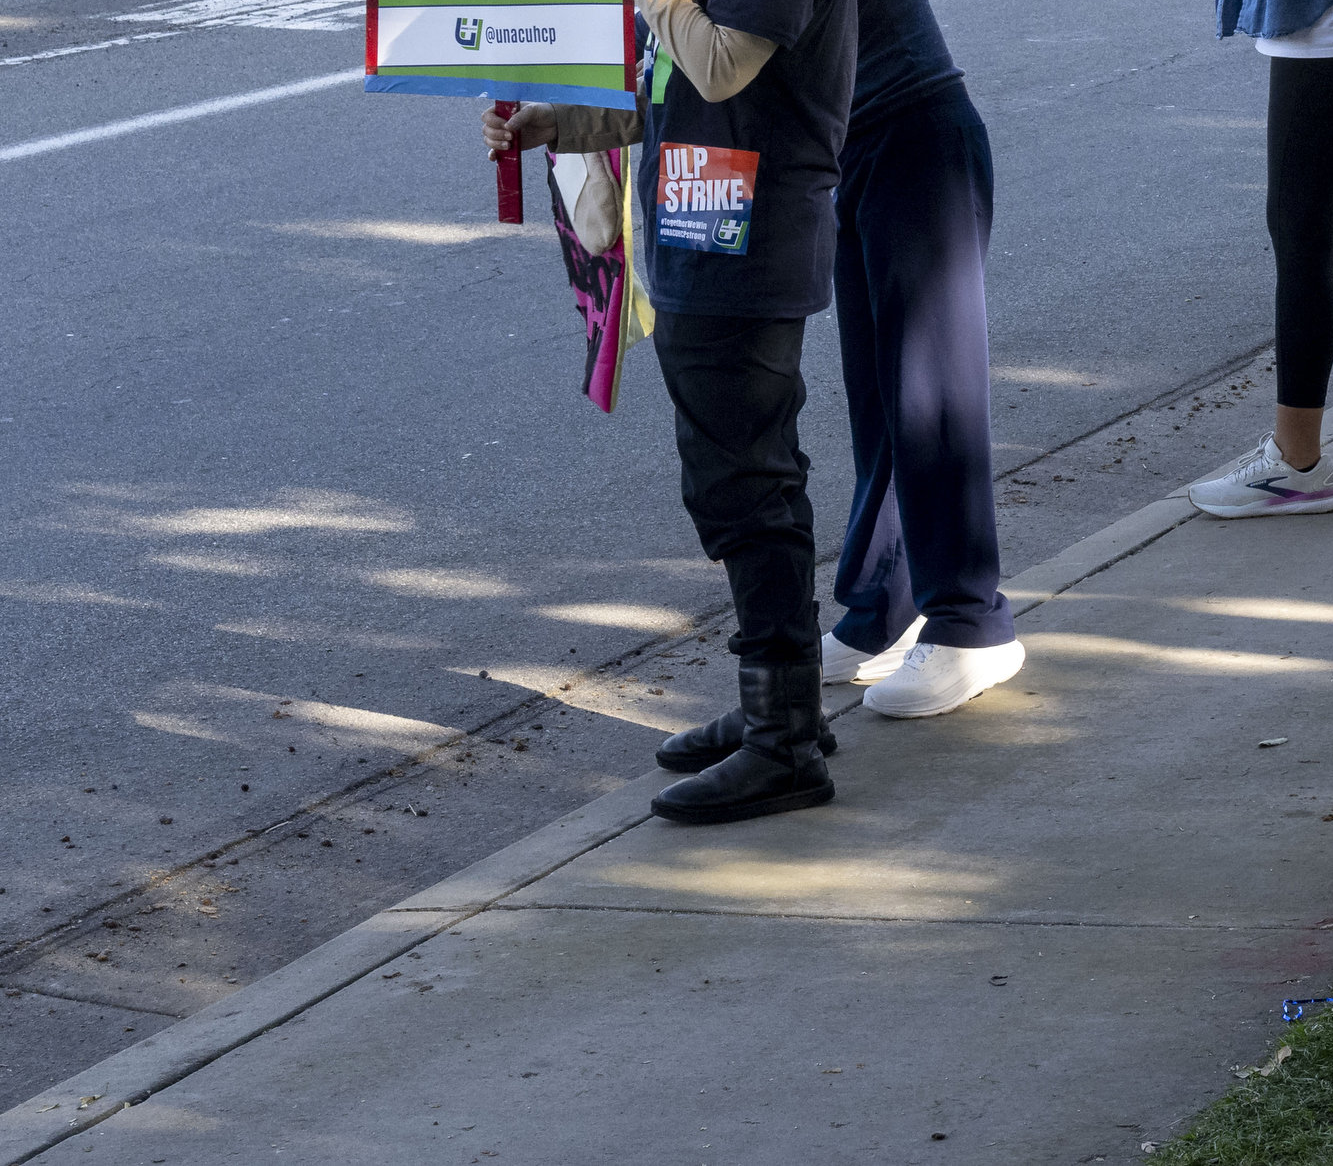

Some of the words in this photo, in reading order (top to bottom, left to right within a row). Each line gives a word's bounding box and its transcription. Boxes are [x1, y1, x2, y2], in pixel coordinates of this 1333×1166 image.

[485, 25, 556, 45] @unacuhcp
[664, 147, 708, 180] ULP
[664, 179, 744, 214] STRIKE
